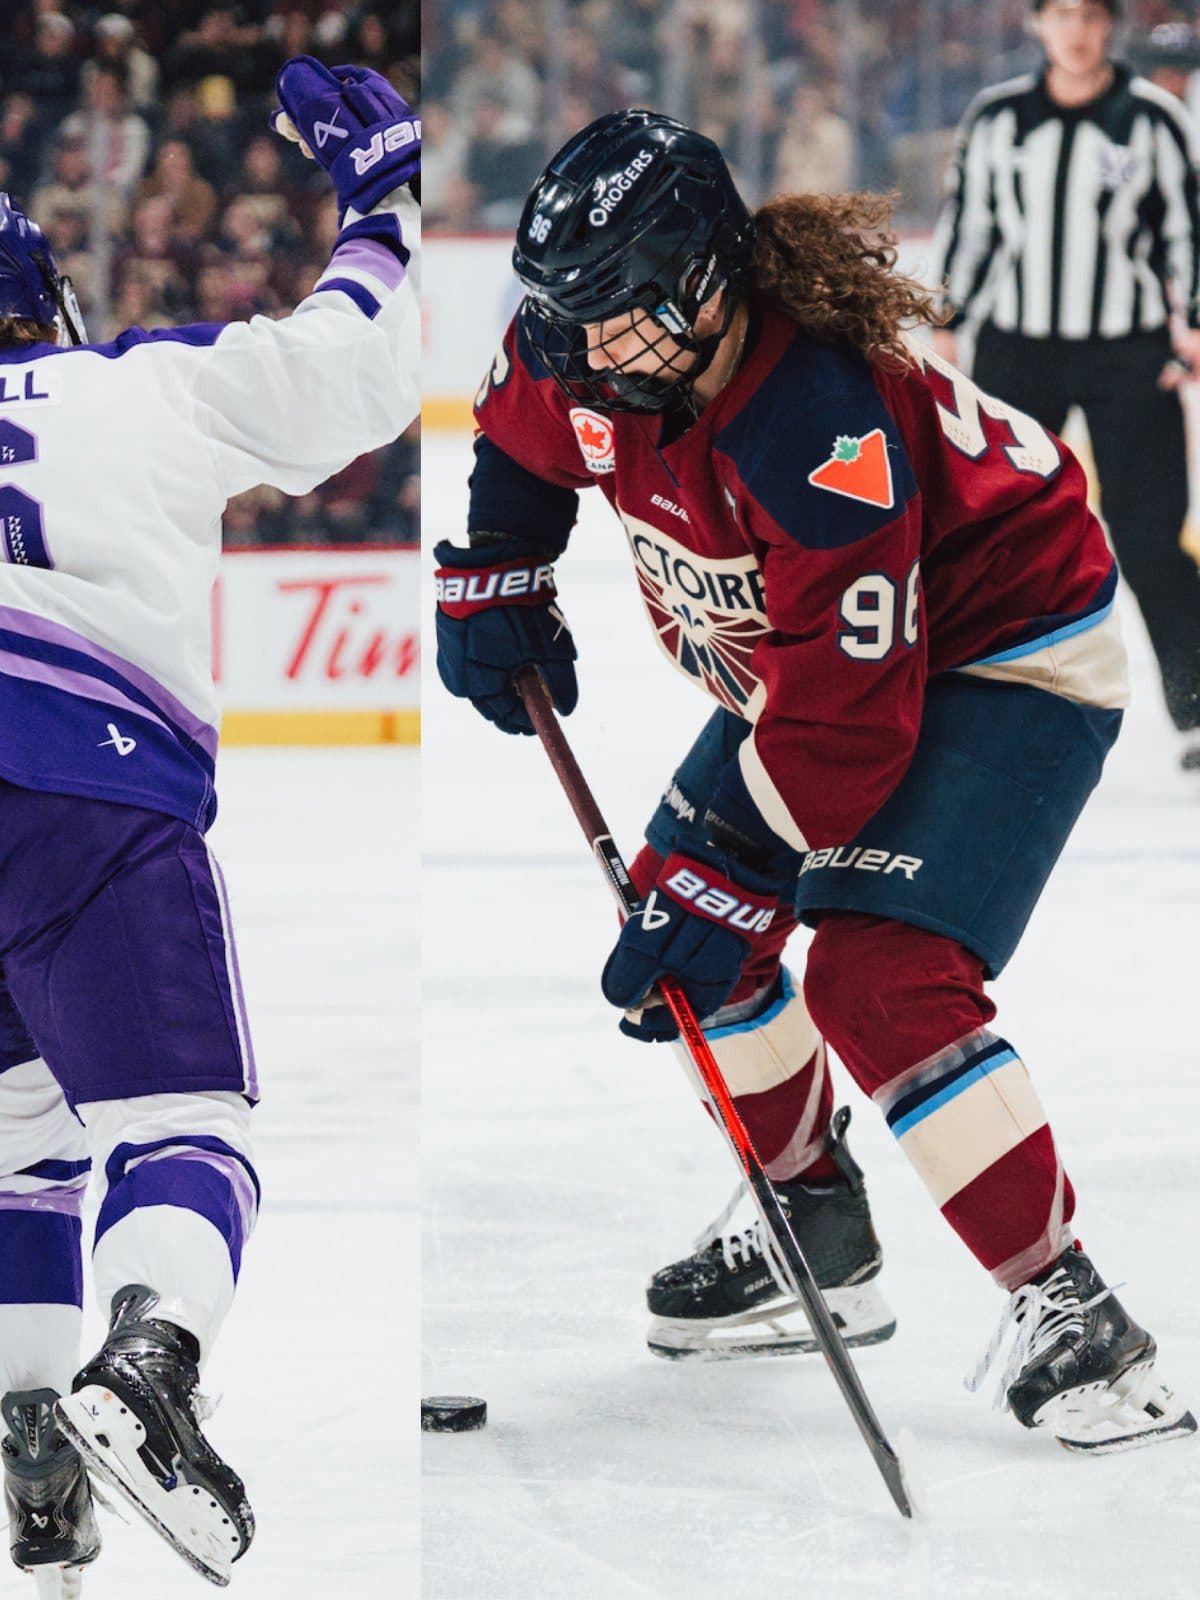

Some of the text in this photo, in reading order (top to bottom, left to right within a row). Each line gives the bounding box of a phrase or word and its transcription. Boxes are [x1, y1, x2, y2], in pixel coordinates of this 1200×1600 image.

[599, 149, 653, 213] ROGERS
[528, 213, 552, 244] 96
[633, 534, 767, 615] CTOIRE
[798, 847, 924, 880] BAUER
